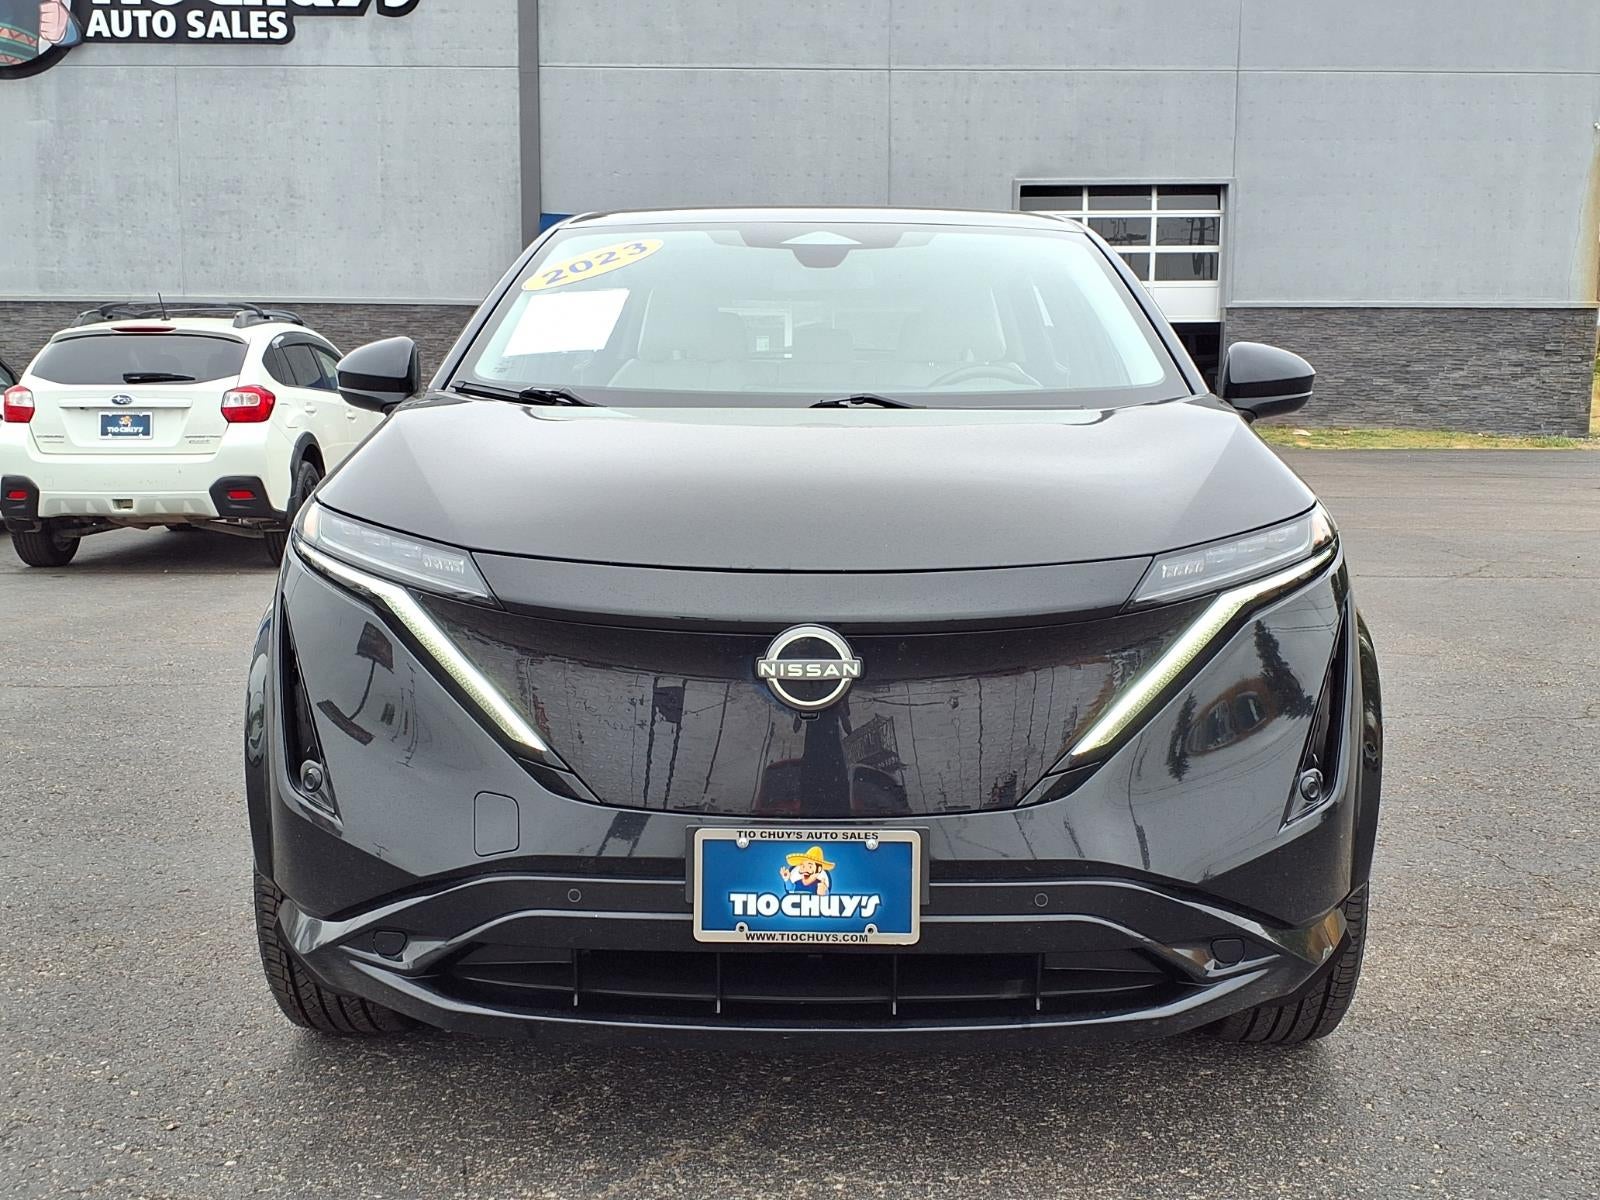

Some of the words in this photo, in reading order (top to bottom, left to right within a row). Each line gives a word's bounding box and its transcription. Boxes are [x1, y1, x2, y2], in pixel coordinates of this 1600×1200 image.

[85, 9, 177, 39] AUTO
[186, 9, 288, 40] SALES
[541, 242, 648, 285] 2023
[760, 663, 859, 677] NISSAN
[736, 830, 756, 839] TIO
[760, 830, 803, 840] CHUY'S
[806, 831, 839, 840] AUTO
[842, 831, 879, 841] SALES
[744, 932, 869, 943] WWW.TIOCHUYS.COM
